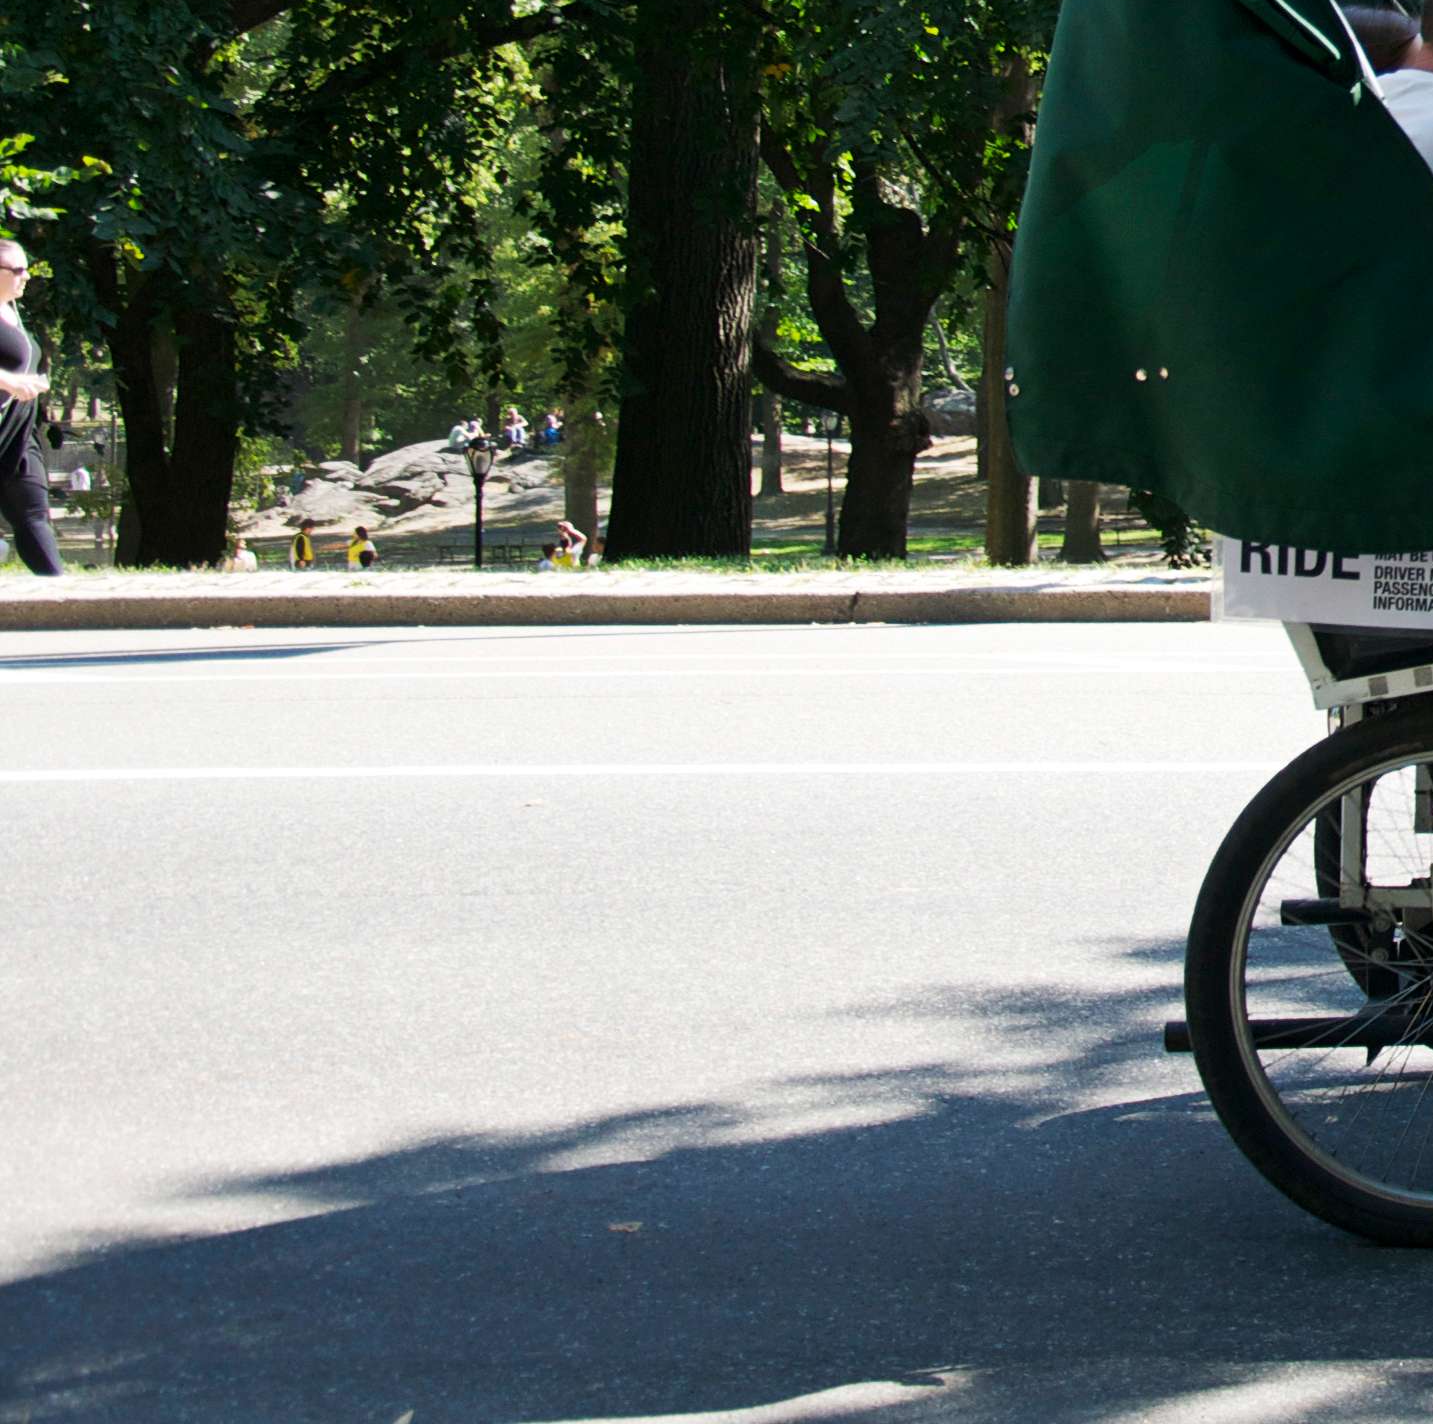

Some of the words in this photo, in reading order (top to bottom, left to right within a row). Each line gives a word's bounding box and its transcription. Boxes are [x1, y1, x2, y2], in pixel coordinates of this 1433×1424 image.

[1240, 540, 1361, 581] RIDE
[1410, 550, 1429, 563] BE
[1373, 565, 1426, 582] DRIVER
